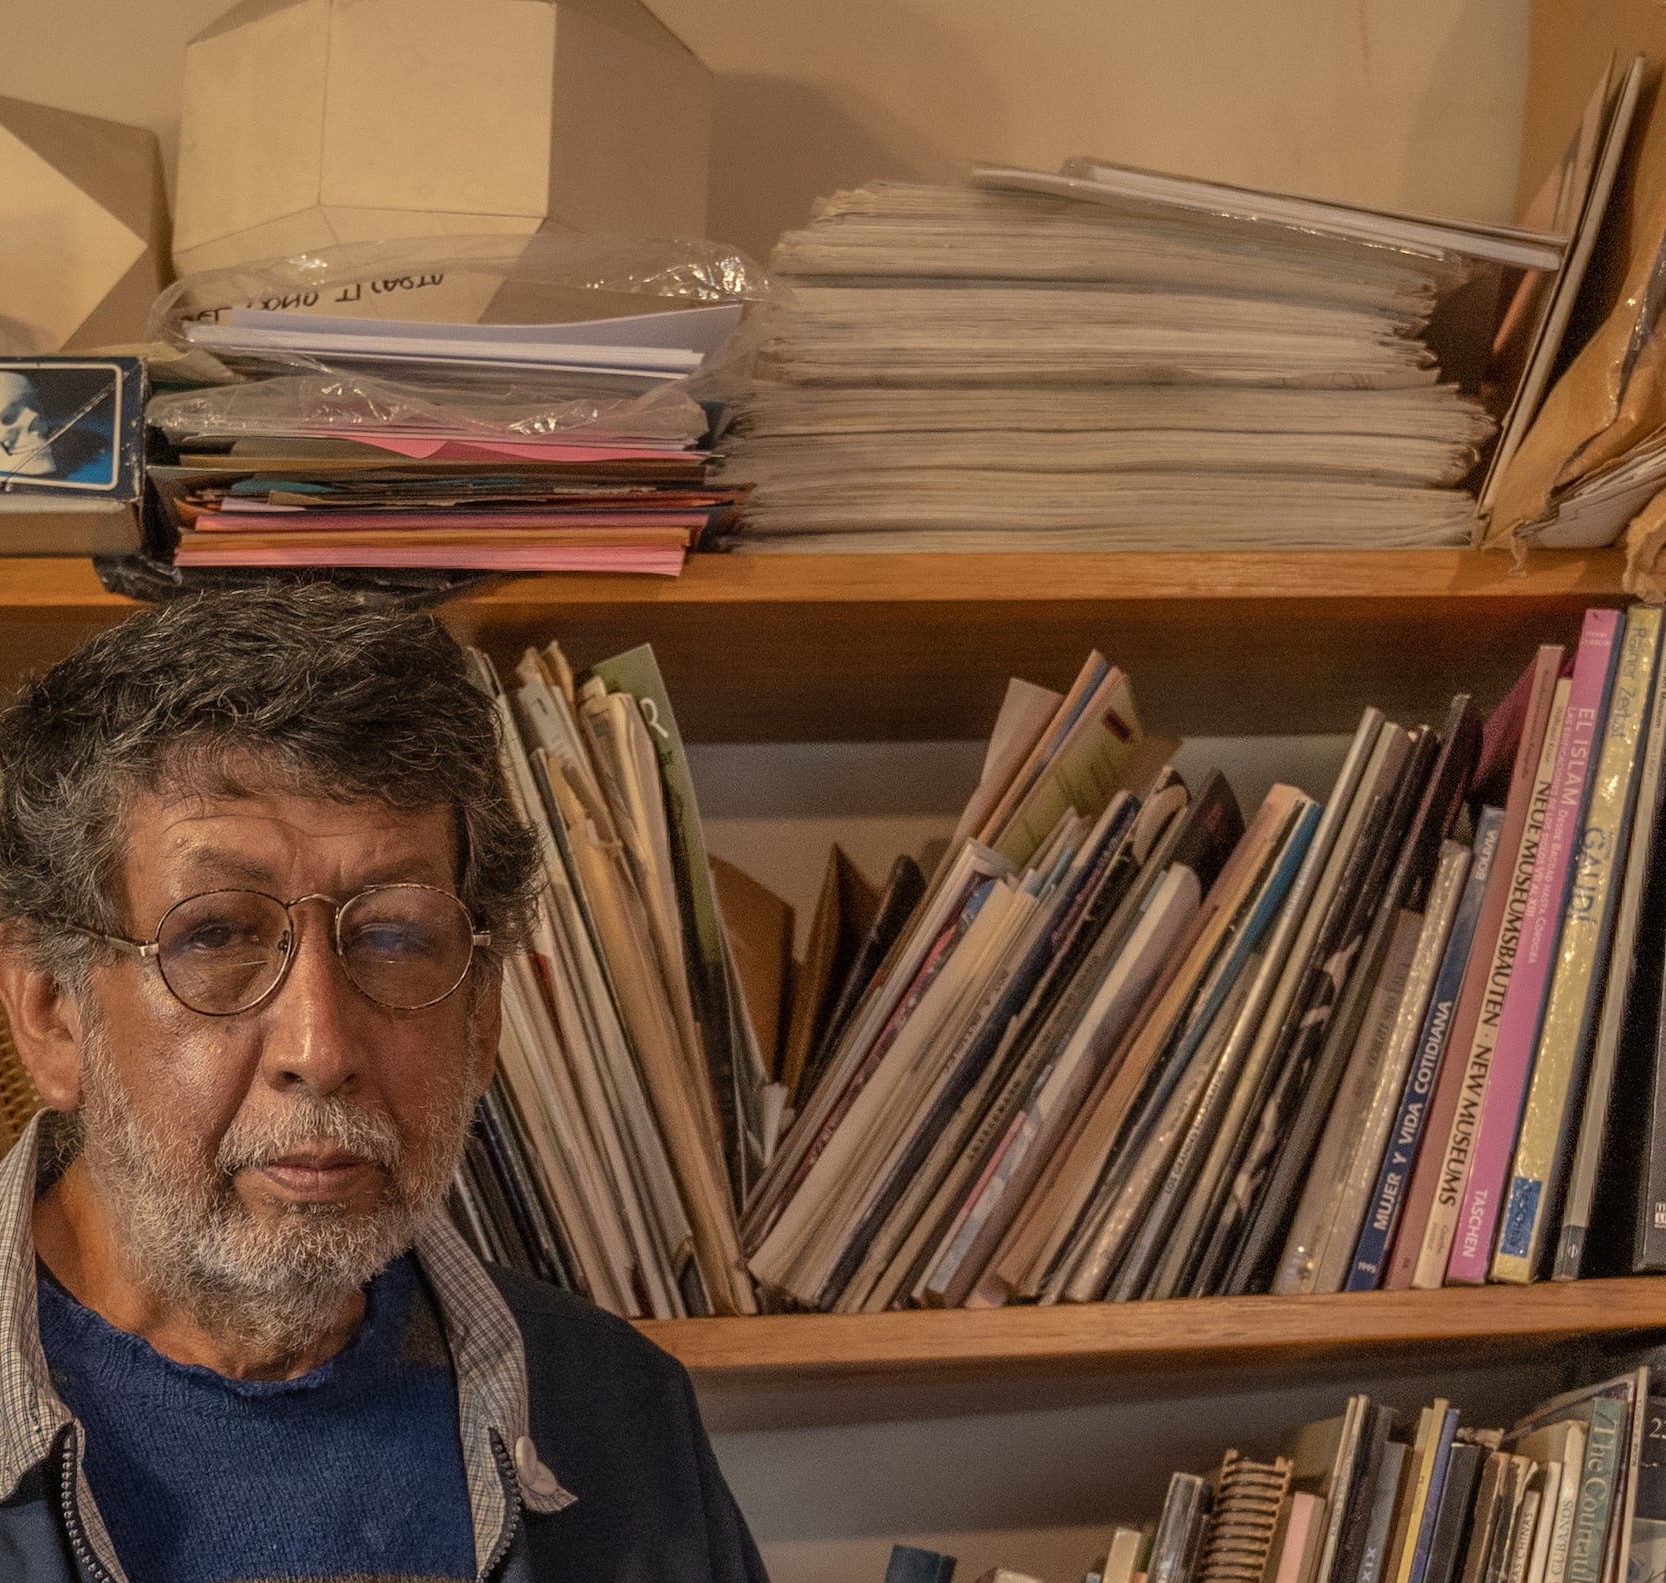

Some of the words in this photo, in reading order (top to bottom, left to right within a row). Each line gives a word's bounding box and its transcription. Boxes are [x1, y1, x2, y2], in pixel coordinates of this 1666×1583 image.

[1652, 690, 1666, 729] Museum
[1525, 778, 1555, 837] NEUE
[1474, 828, 1497, 880] BOLIVIA
[1481, 837, 1542, 1027] MUSEUMSBAUTEN
[1411, 998, 1454, 1095] COTIDIANA
[1464, 1043, 1492, 1095] NEW
[1396, 1099, 1423, 1147] VIDA
[1437, 1095, 1479, 1207] MUSEUMS
[1391, 1151, 1407, 1167] Y
[1371, 1172, 1402, 1231] MUJER
[1460, 1187, 1488, 1258] TASCHEN
[1586, 1417, 1619, 1472] The
[1360, 1544, 1377, 1581] XIX
[1547, 1498, 1578, 1576] CUBANOS
